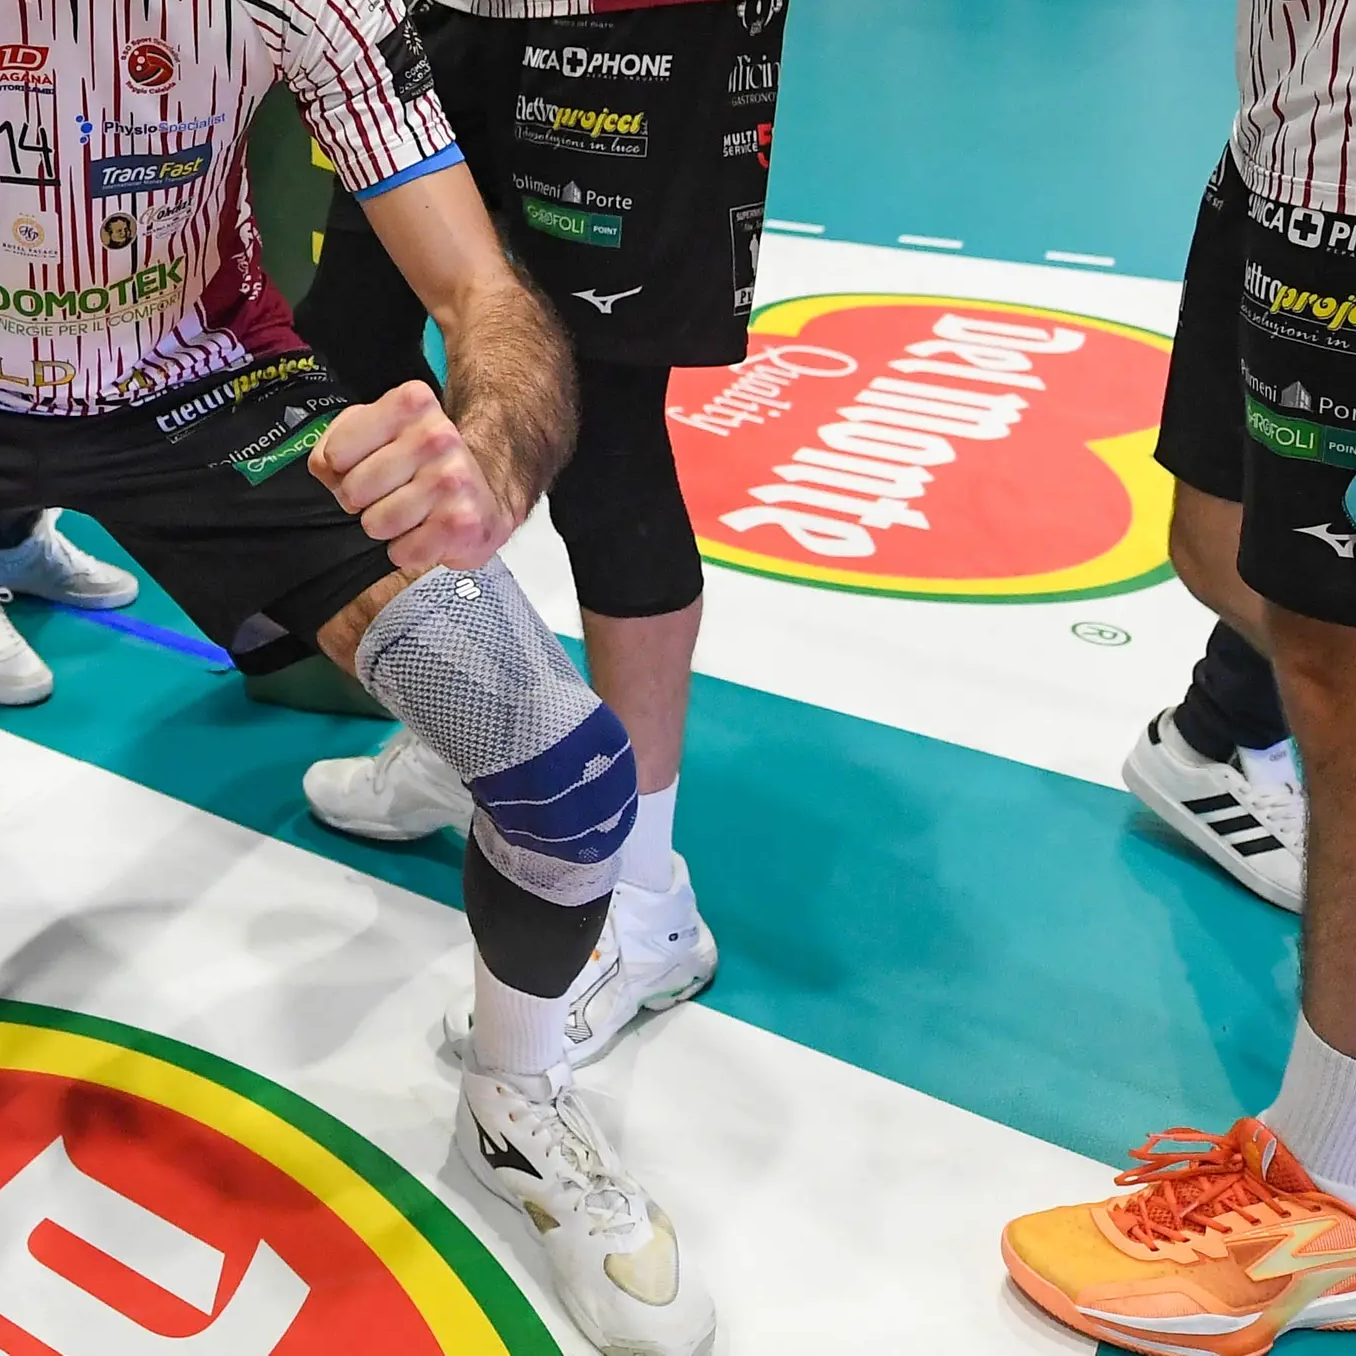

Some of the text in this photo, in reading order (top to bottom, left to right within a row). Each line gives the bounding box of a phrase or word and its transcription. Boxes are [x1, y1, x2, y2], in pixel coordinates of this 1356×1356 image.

[587, 53, 673, 77] PHONE
[723, 129, 758, 147] MULTI
[102, 156, 204, 185] Trans Fast
[586, 190, 633, 210] Porte
[592, 225, 618, 236] POINT
[58, 323, 88, 337] PER
[92, 321, 106, 333] IL
[108, 290, 183, 328] COMFORT
[666, 344, 860, 438] Quality
[1327, 441, 1356, 455] POIN
